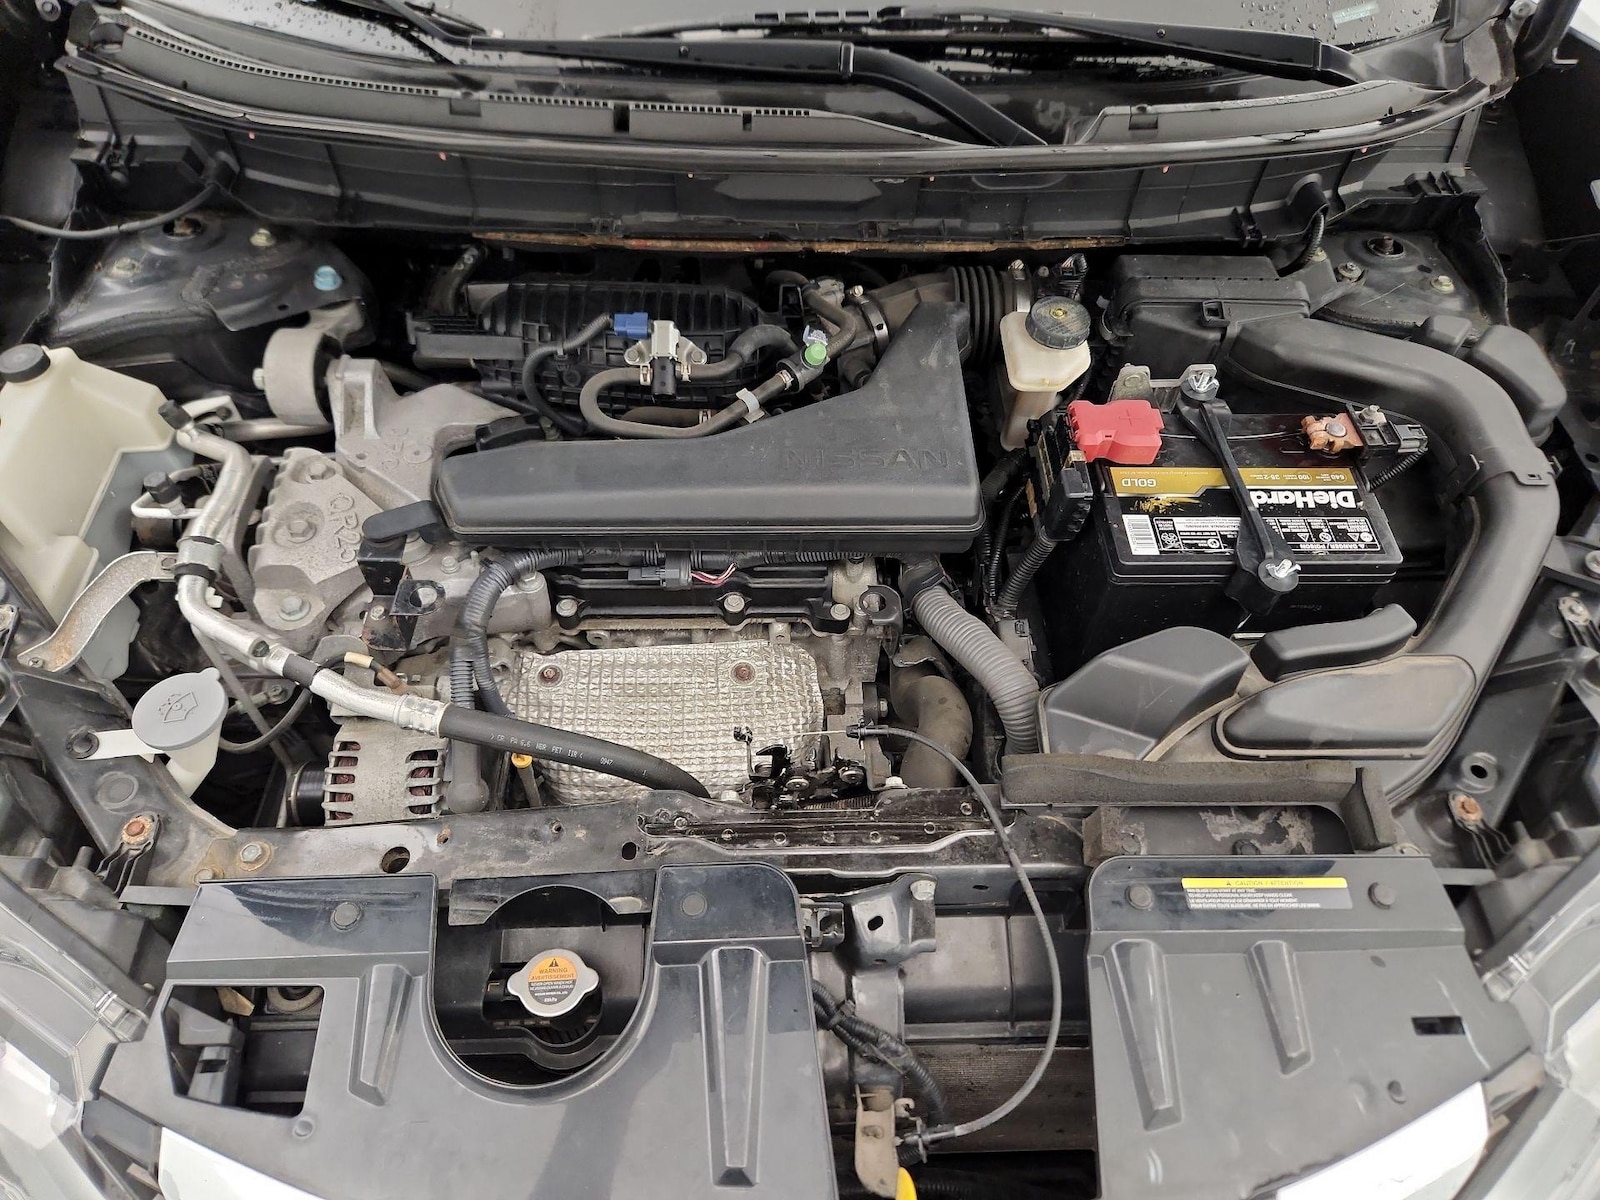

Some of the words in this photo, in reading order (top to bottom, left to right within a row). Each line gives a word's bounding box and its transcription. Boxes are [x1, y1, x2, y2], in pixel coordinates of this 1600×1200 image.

[785, 449, 950, 469] NISSAN
[1121, 478, 1156, 488] GOLD
[1250, 490, 1356, 509] DieHard
